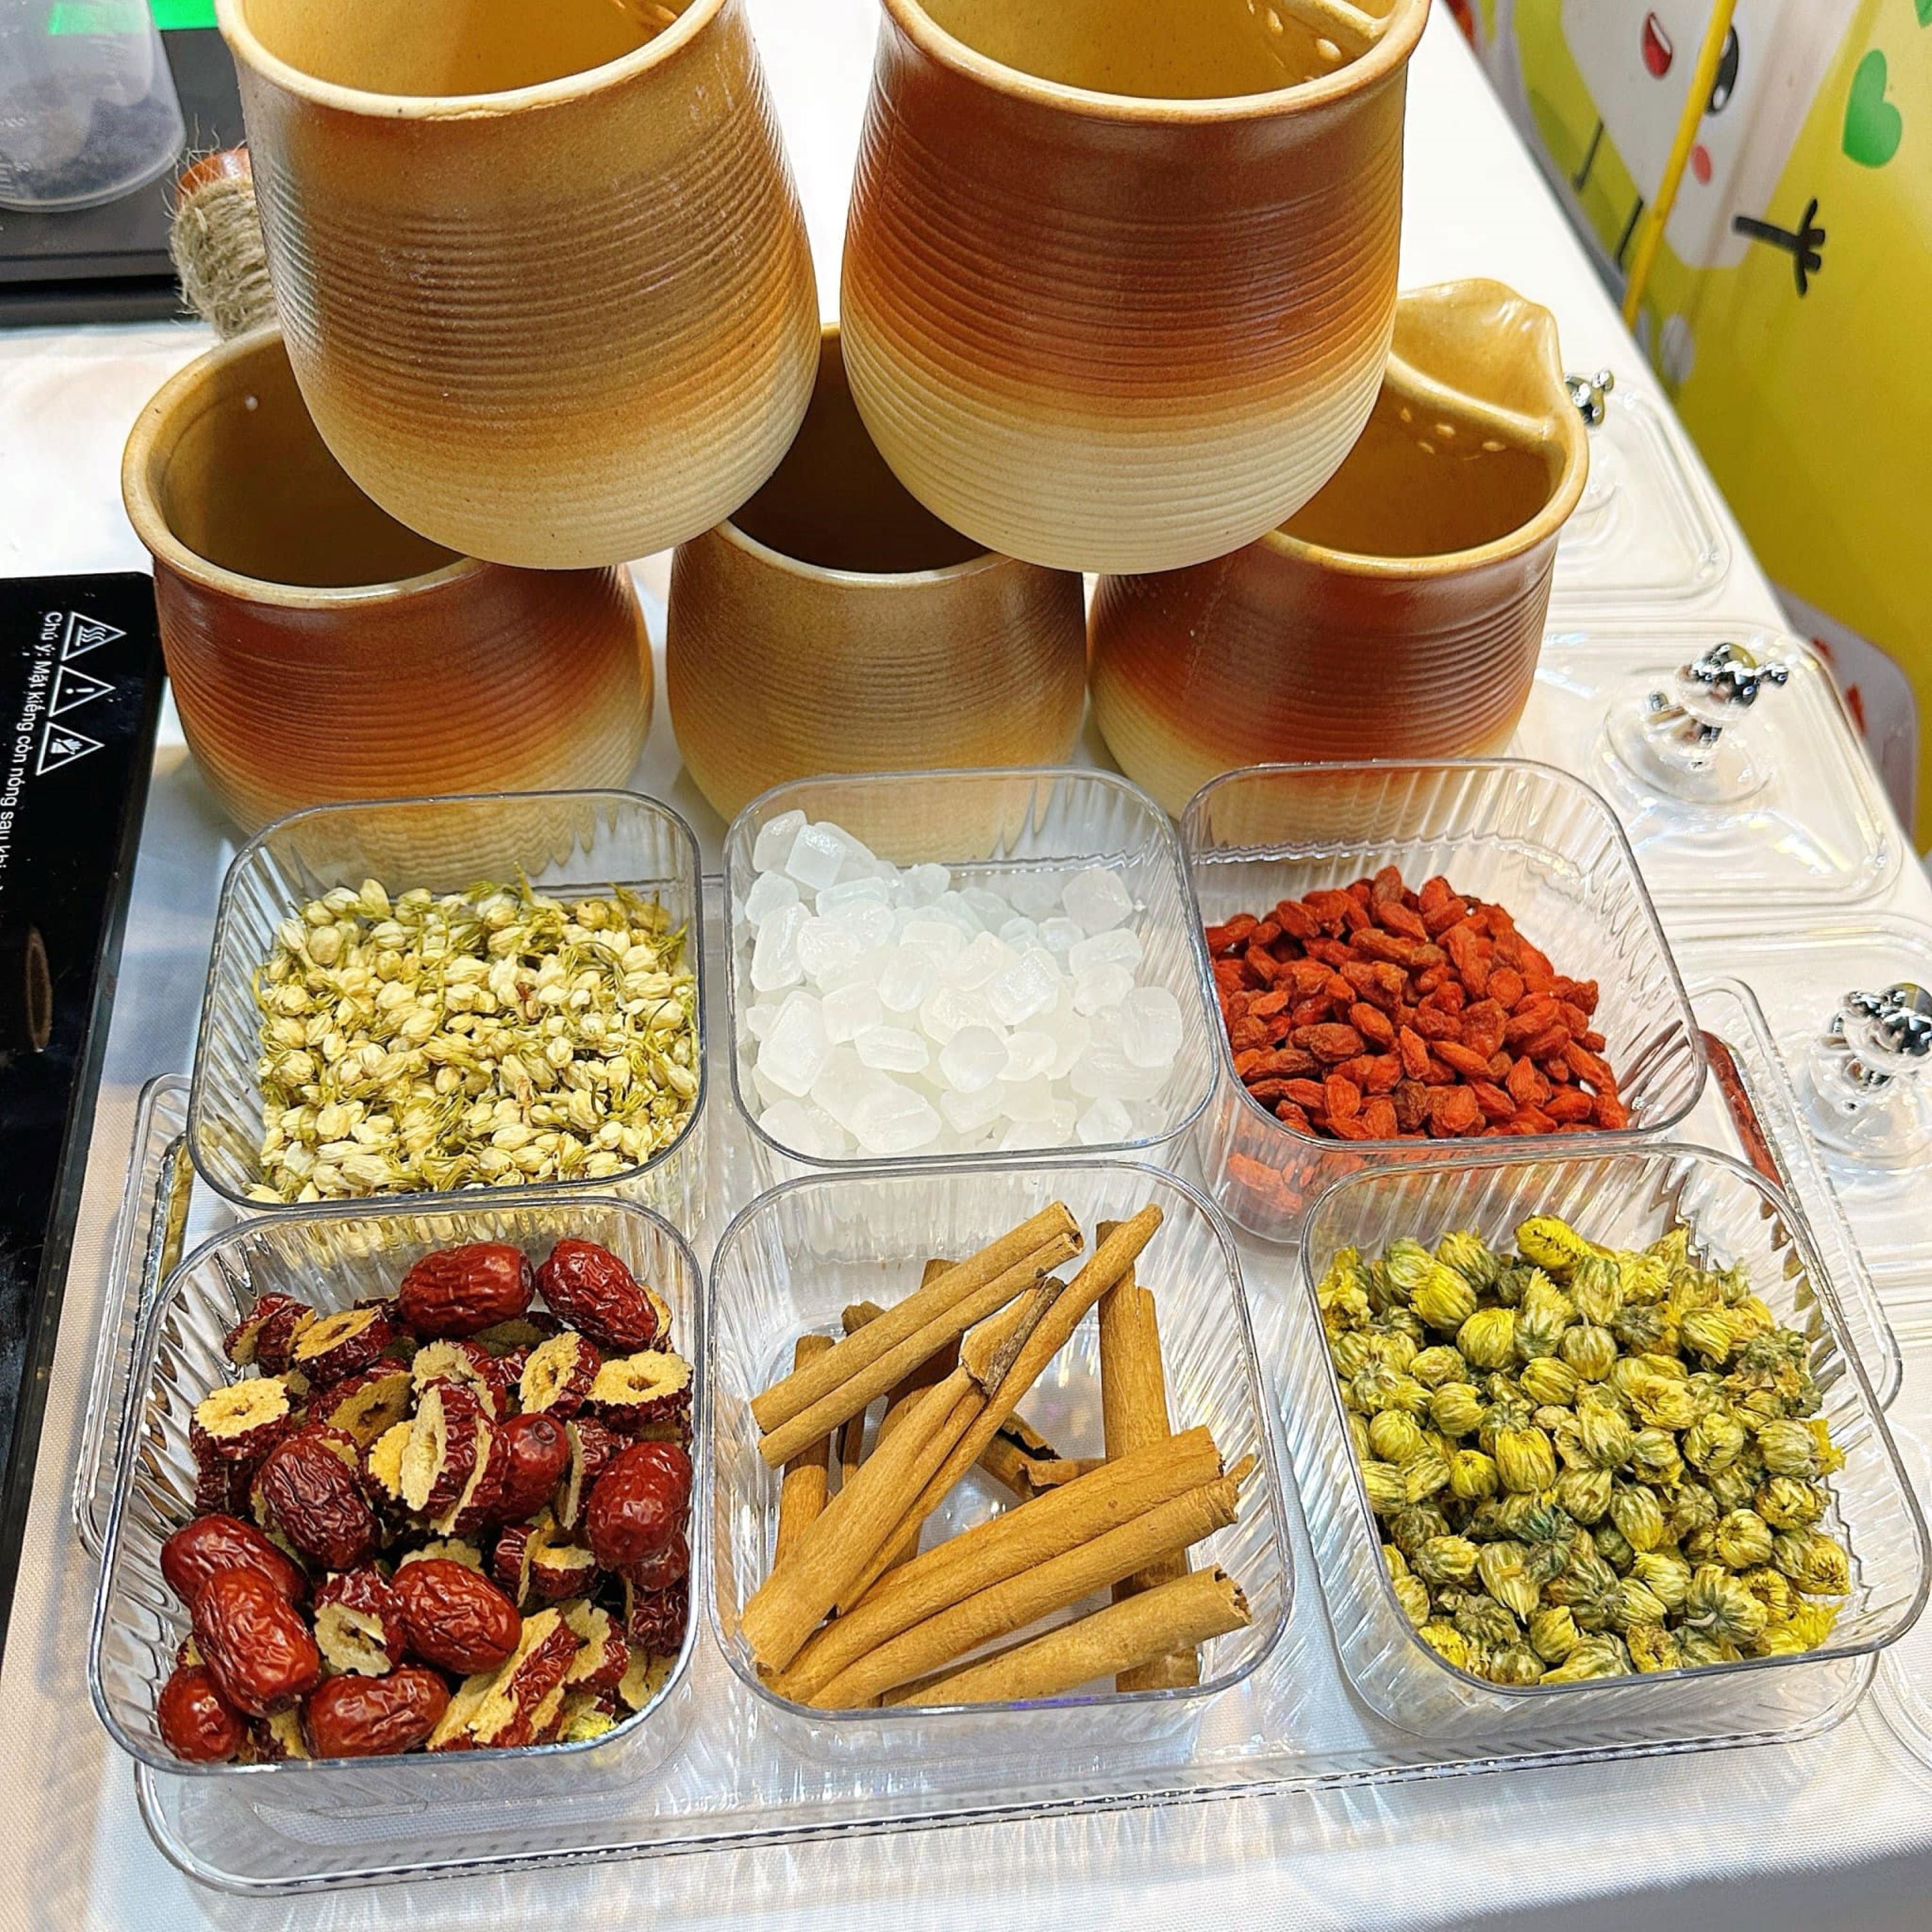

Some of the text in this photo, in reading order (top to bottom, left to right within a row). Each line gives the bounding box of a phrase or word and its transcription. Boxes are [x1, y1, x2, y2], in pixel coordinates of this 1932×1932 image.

[41, 611, 63, 641] Chú
[28, 661, 52, 688] Mặt
[16, 691, 46, 732] kiếng
[12, 735, 33, 763] còn
[0, 768, 26, 806] nóng
[0, 811, 14, 840] sau
